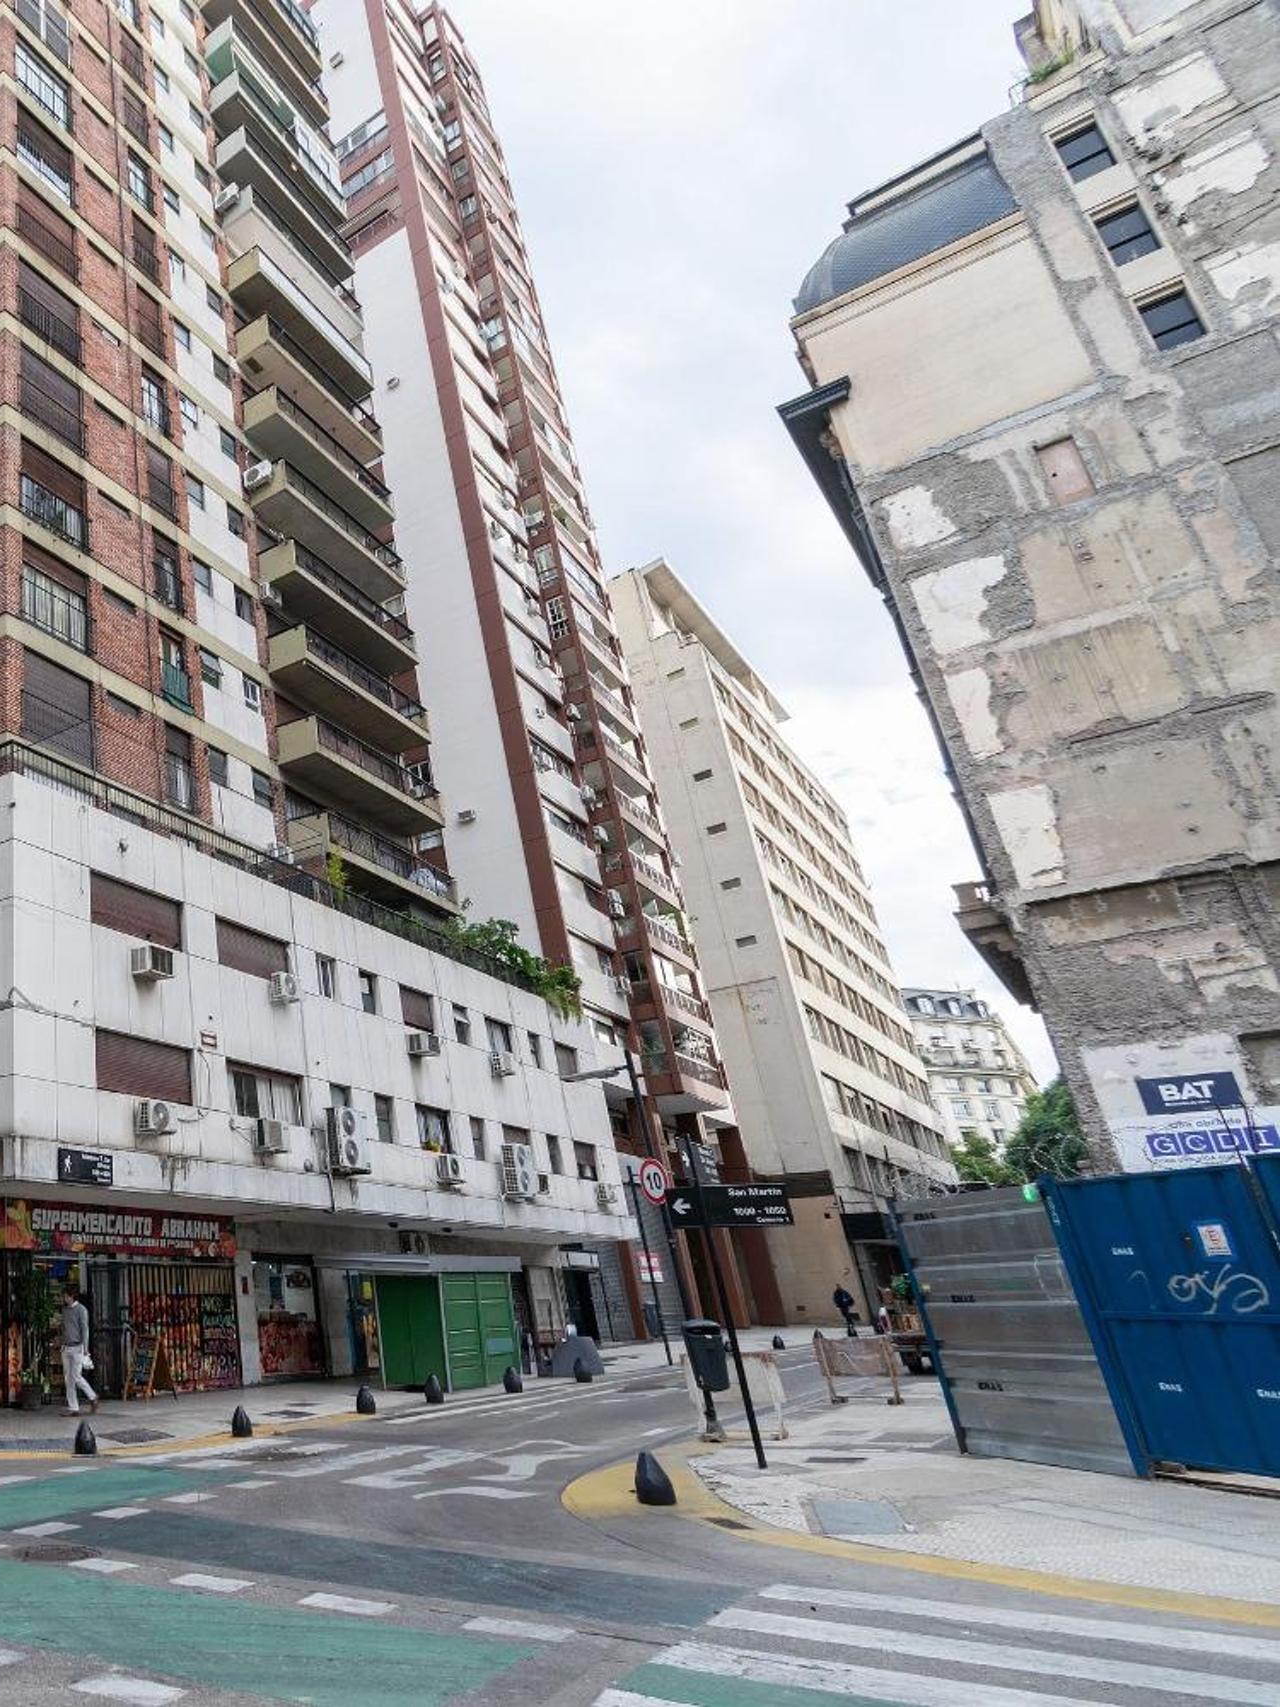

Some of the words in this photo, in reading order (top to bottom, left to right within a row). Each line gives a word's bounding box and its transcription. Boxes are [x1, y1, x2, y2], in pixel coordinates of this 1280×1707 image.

[1158, 1080, 1215, 1101] BAT
[646, 1172, 662, 1190] 10
[728, 1187, 747, 1197] San
[32, 1208, 153, 1237] SUPERMERCADITO
[161, 1217, 219, 1241] ABRAHAM
